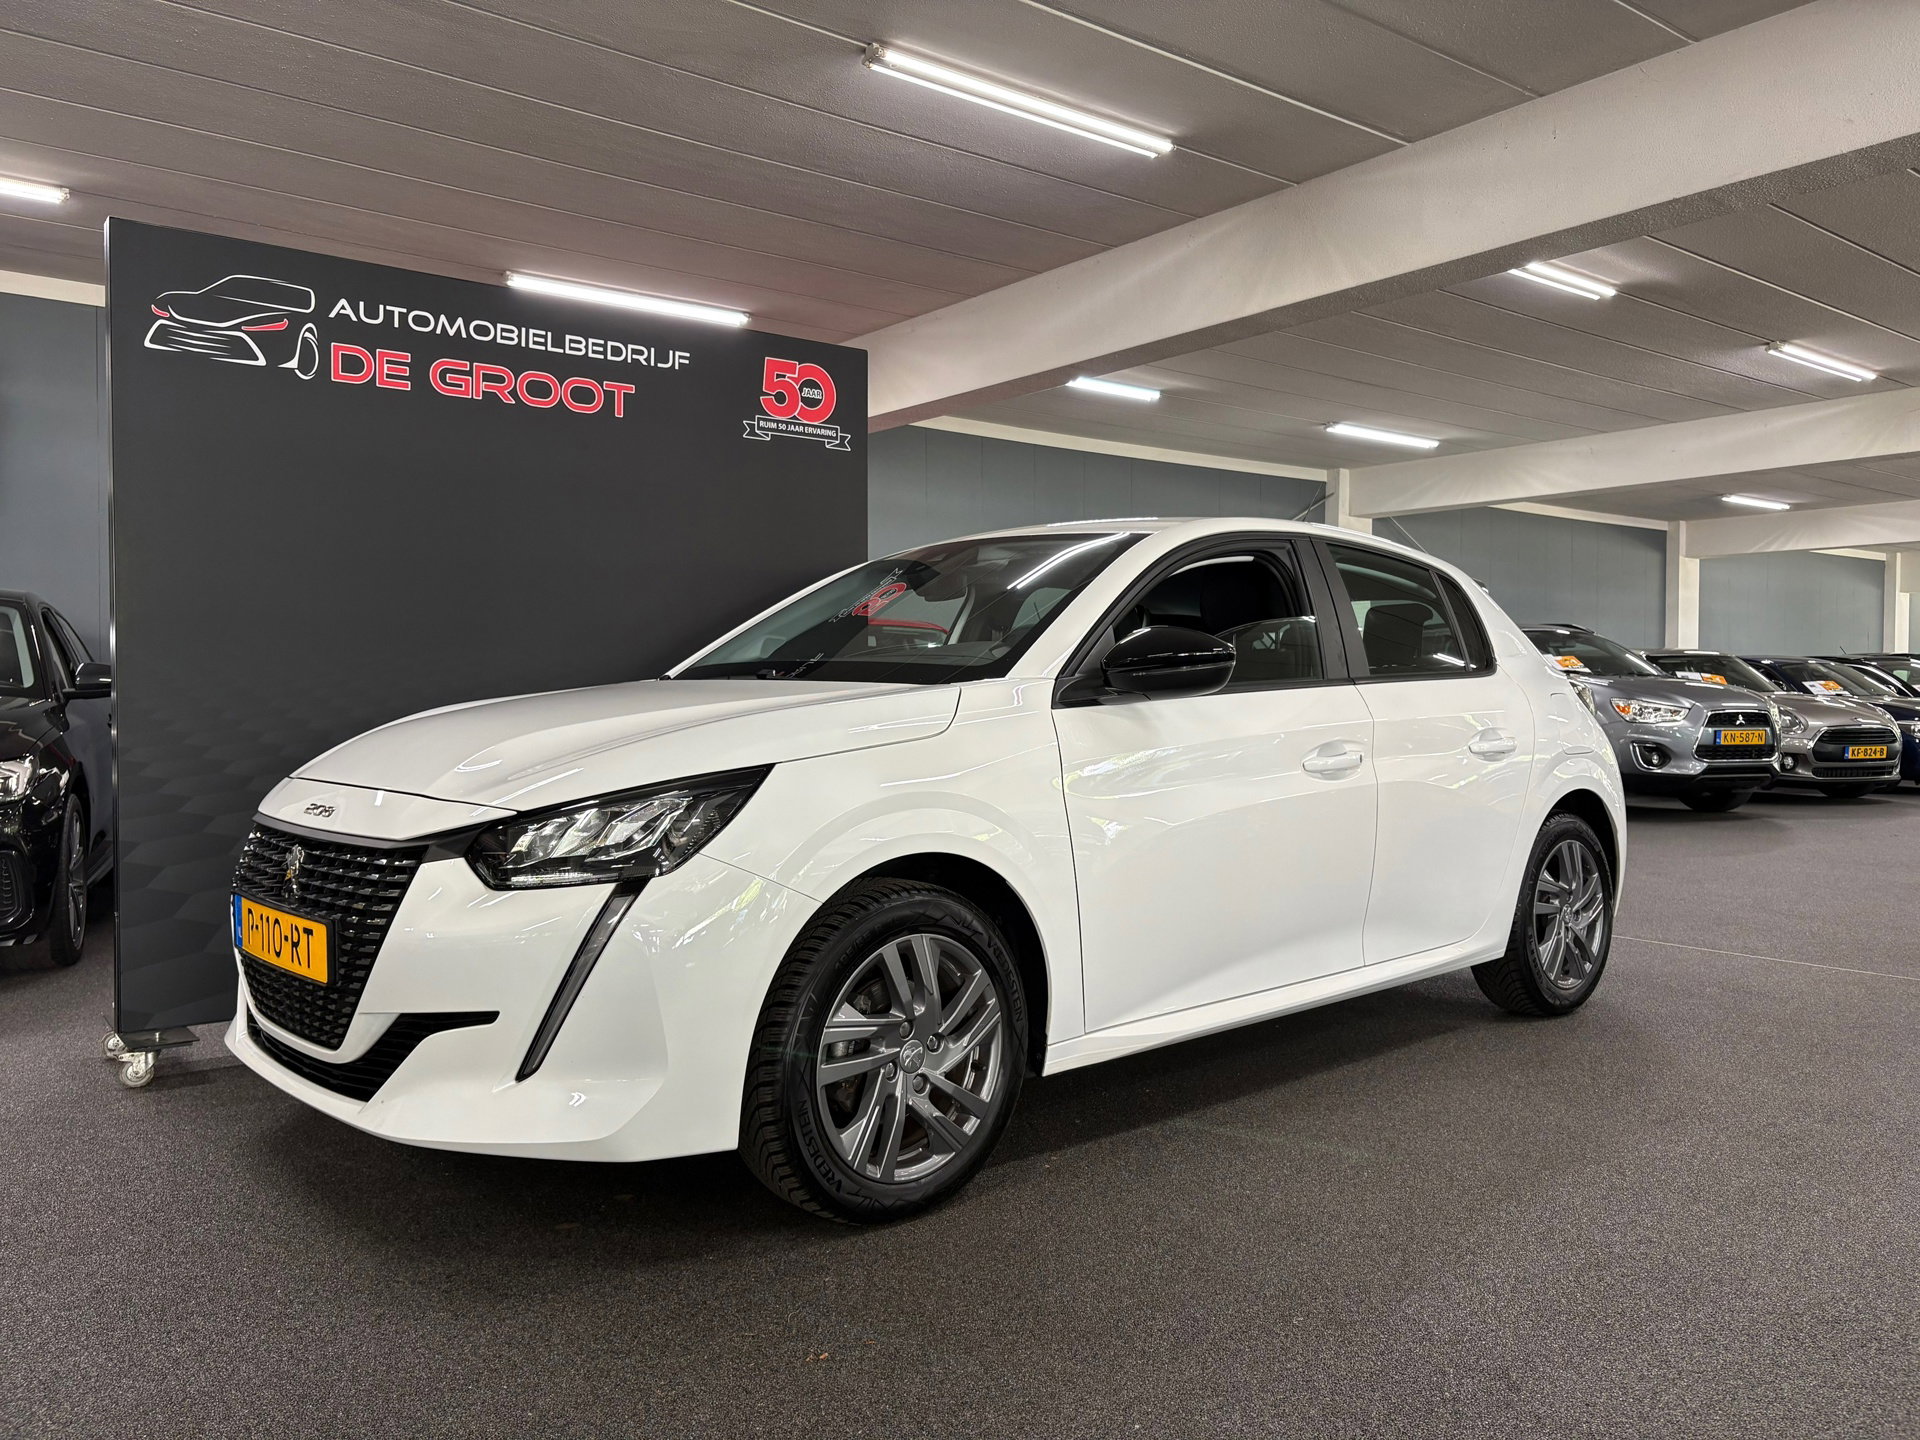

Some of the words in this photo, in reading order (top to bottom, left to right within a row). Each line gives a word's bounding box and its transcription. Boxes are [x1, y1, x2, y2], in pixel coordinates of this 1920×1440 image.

[328, 298, 691, 370] AUTOMOBIELBEDRIJF
[331, 342, 412, 391] DE
[429, 358, 636, 418] GROOT
[760, 357, 837, 424] 50
[801, 387, 823, 400] JAAR
[759, 420, 777, 429] RUIM
[778, 423, 787, 431] 50
[787, 424, 804, 433] JAAR
[804, 426, 837, 437] ERVARING
[1723, 730, 1764, 743] KN-587-N
[1850, 746, 1885, 758] KF-824-B
[247, 907, 314, 969] P-110-RT
[799, 1099, 843, 1193] VREDESTEIN
